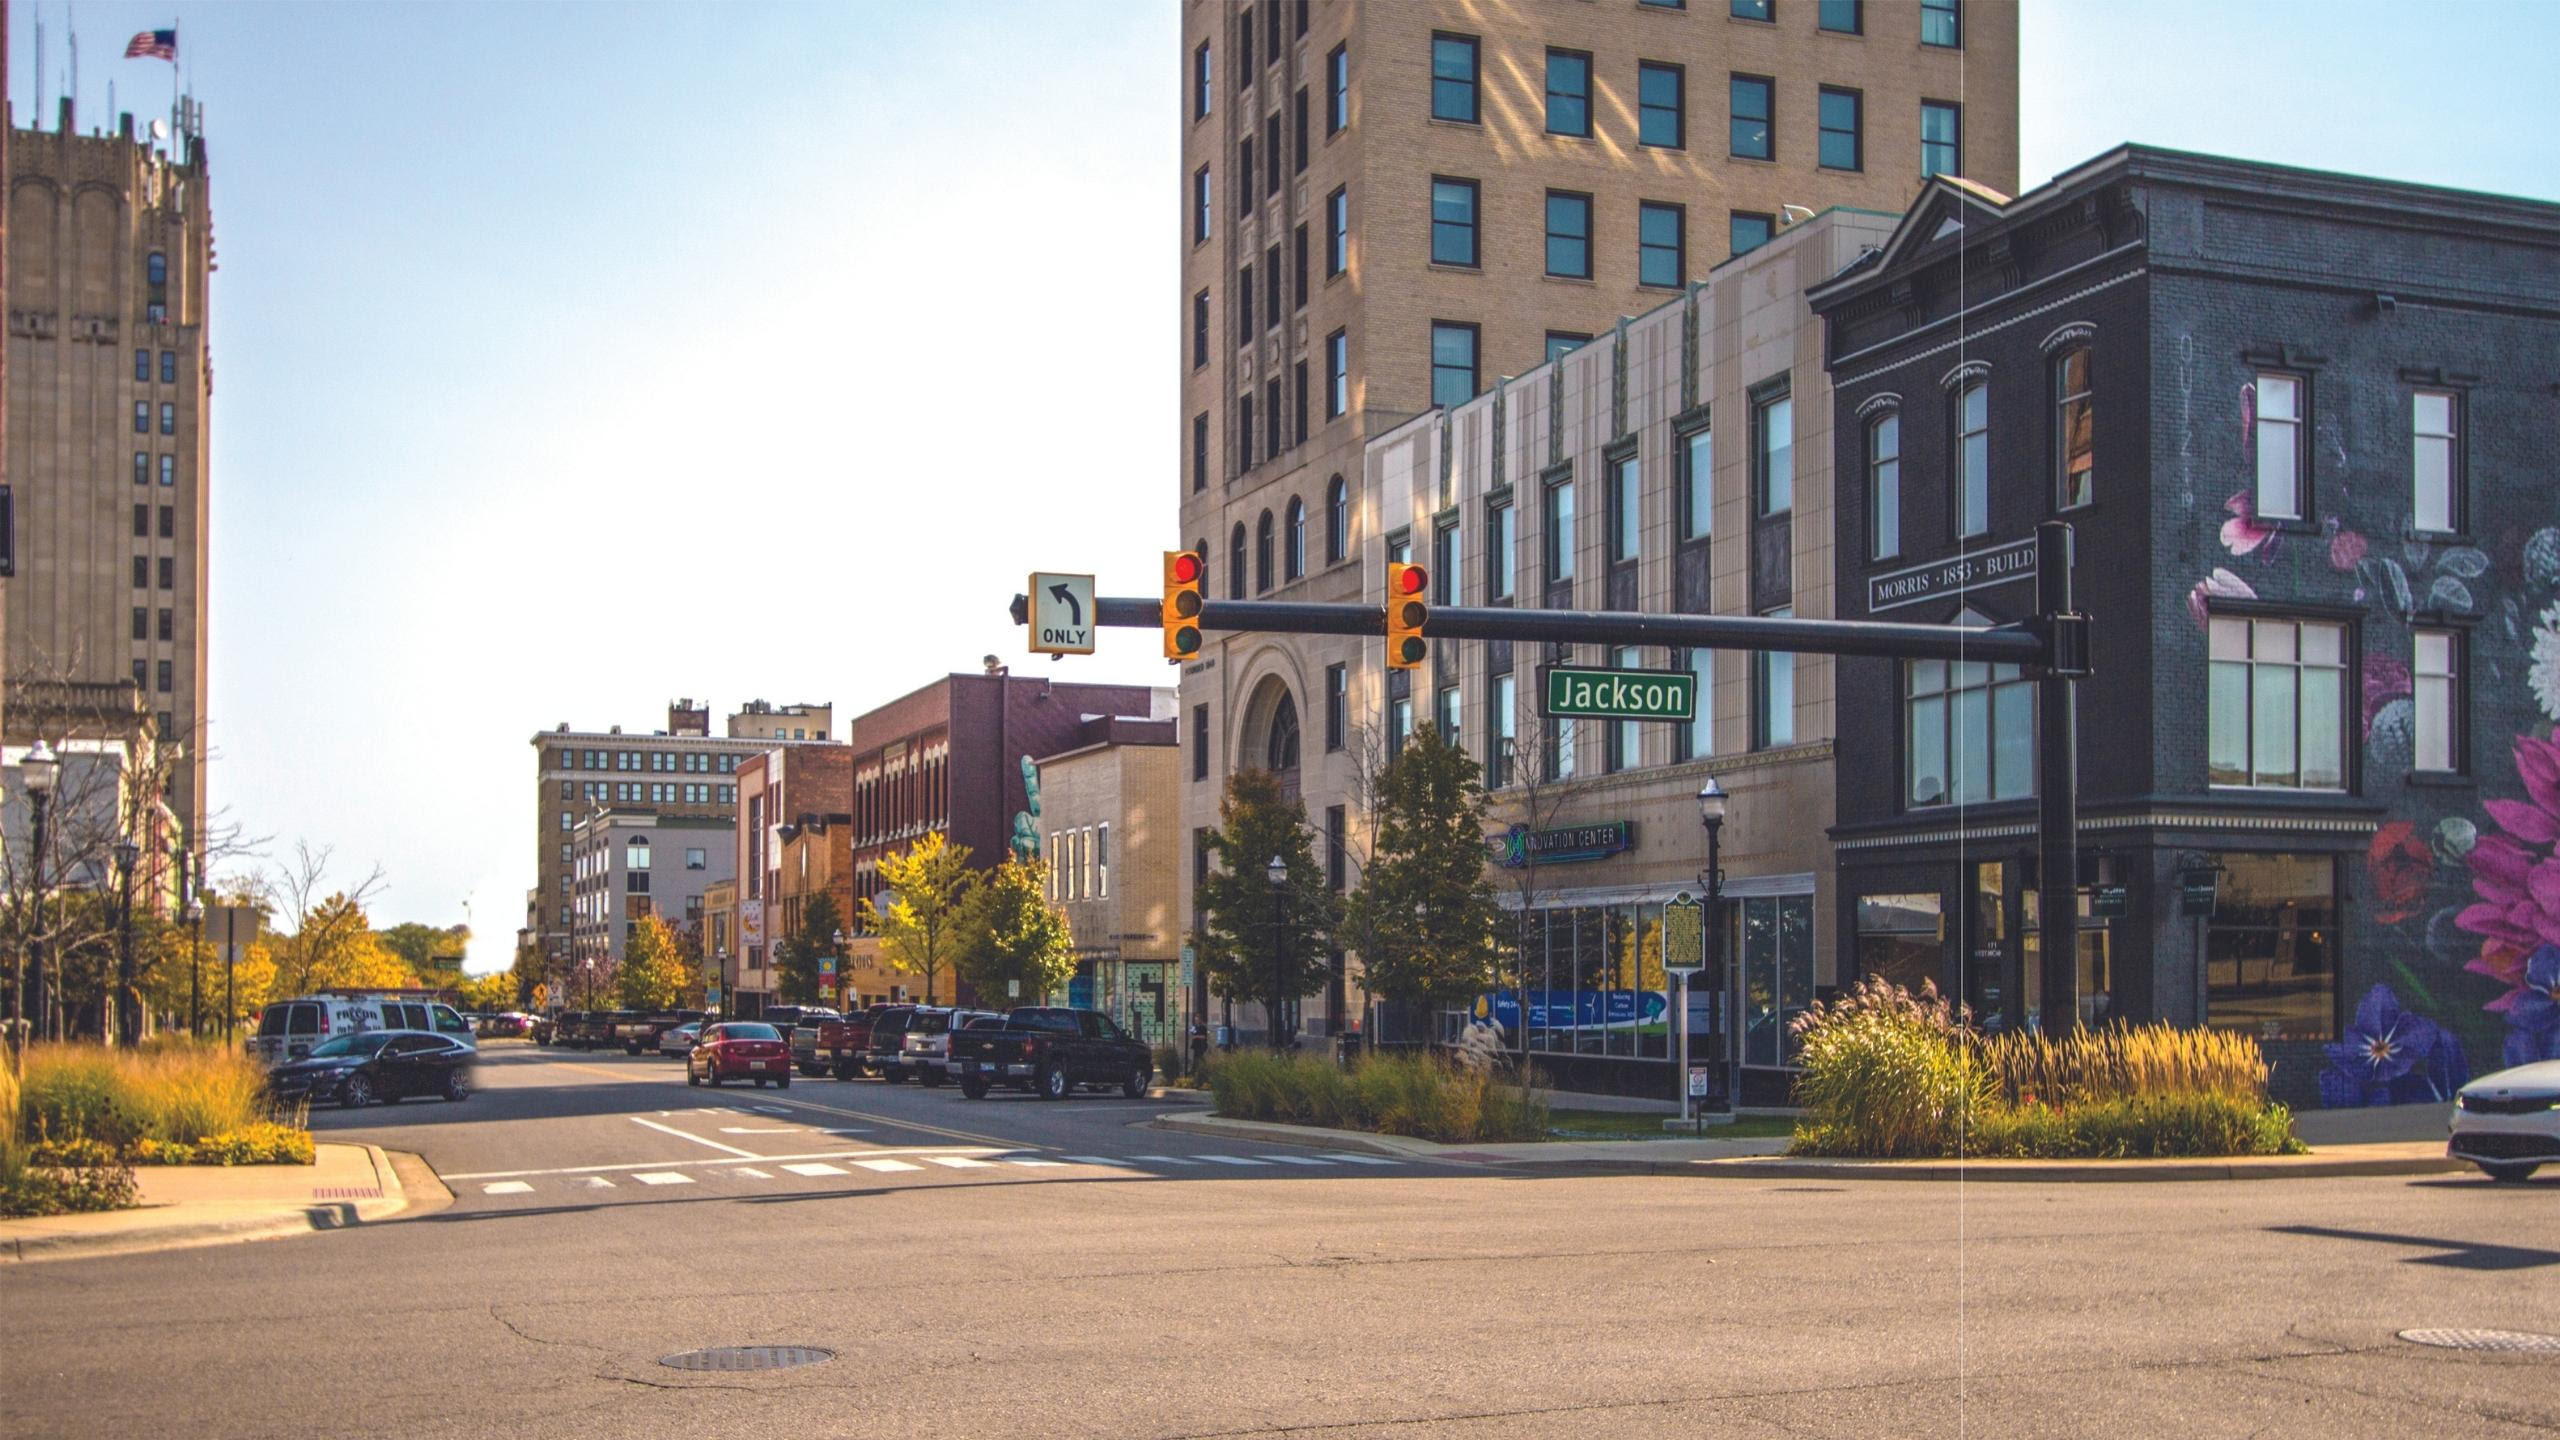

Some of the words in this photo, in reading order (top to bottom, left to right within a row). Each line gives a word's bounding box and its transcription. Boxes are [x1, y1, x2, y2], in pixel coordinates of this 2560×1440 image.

[1878, 574, 1930, 601] MORRIS
[1942, 562, 1972, 586] 1853
[1986, 548, 2036, 576] BUILD
[1043, 628, 1086, 645] ONLY
[1559, 676, 1682, 711] Jackson
[1578, 828, 1615, 848] CENTER
[1497, 1000, 1510, 1009] Safety
